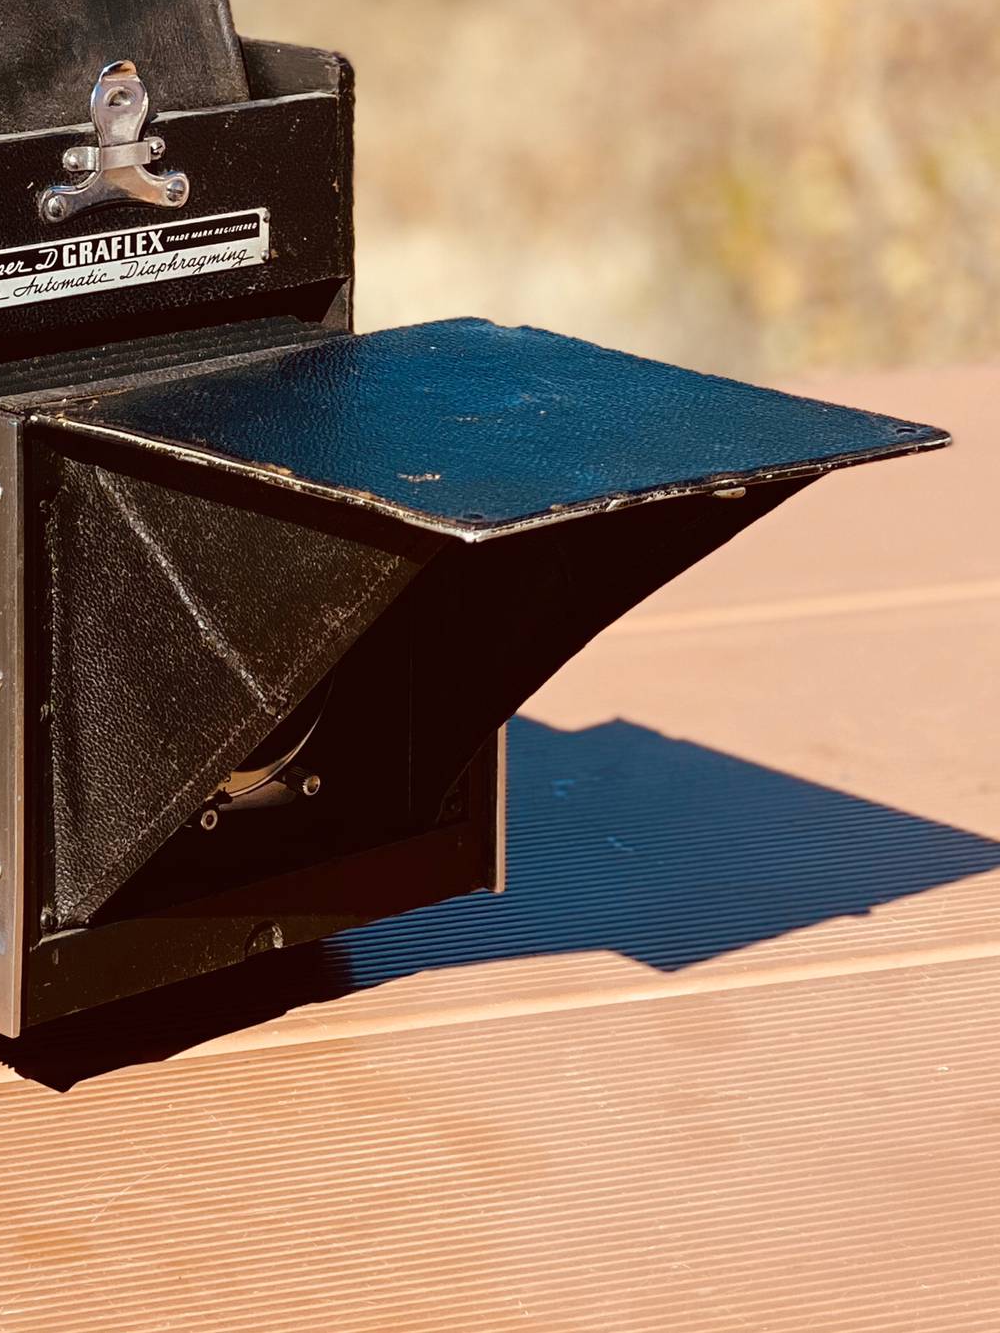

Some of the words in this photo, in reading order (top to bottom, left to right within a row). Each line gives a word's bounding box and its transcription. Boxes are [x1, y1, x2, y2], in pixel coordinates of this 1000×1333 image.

[35, 248, 58, 270] D
[62, 230, 164, 267] GRAFLEX
[166, 233, 190, 242] TRADE
[191, 229, 213, 239] MARK
[214, 222, 258, 235] REGISTERED
[13, 268, 114, 298] Automatic
[119, 247, 254, 281] Diaphragming
